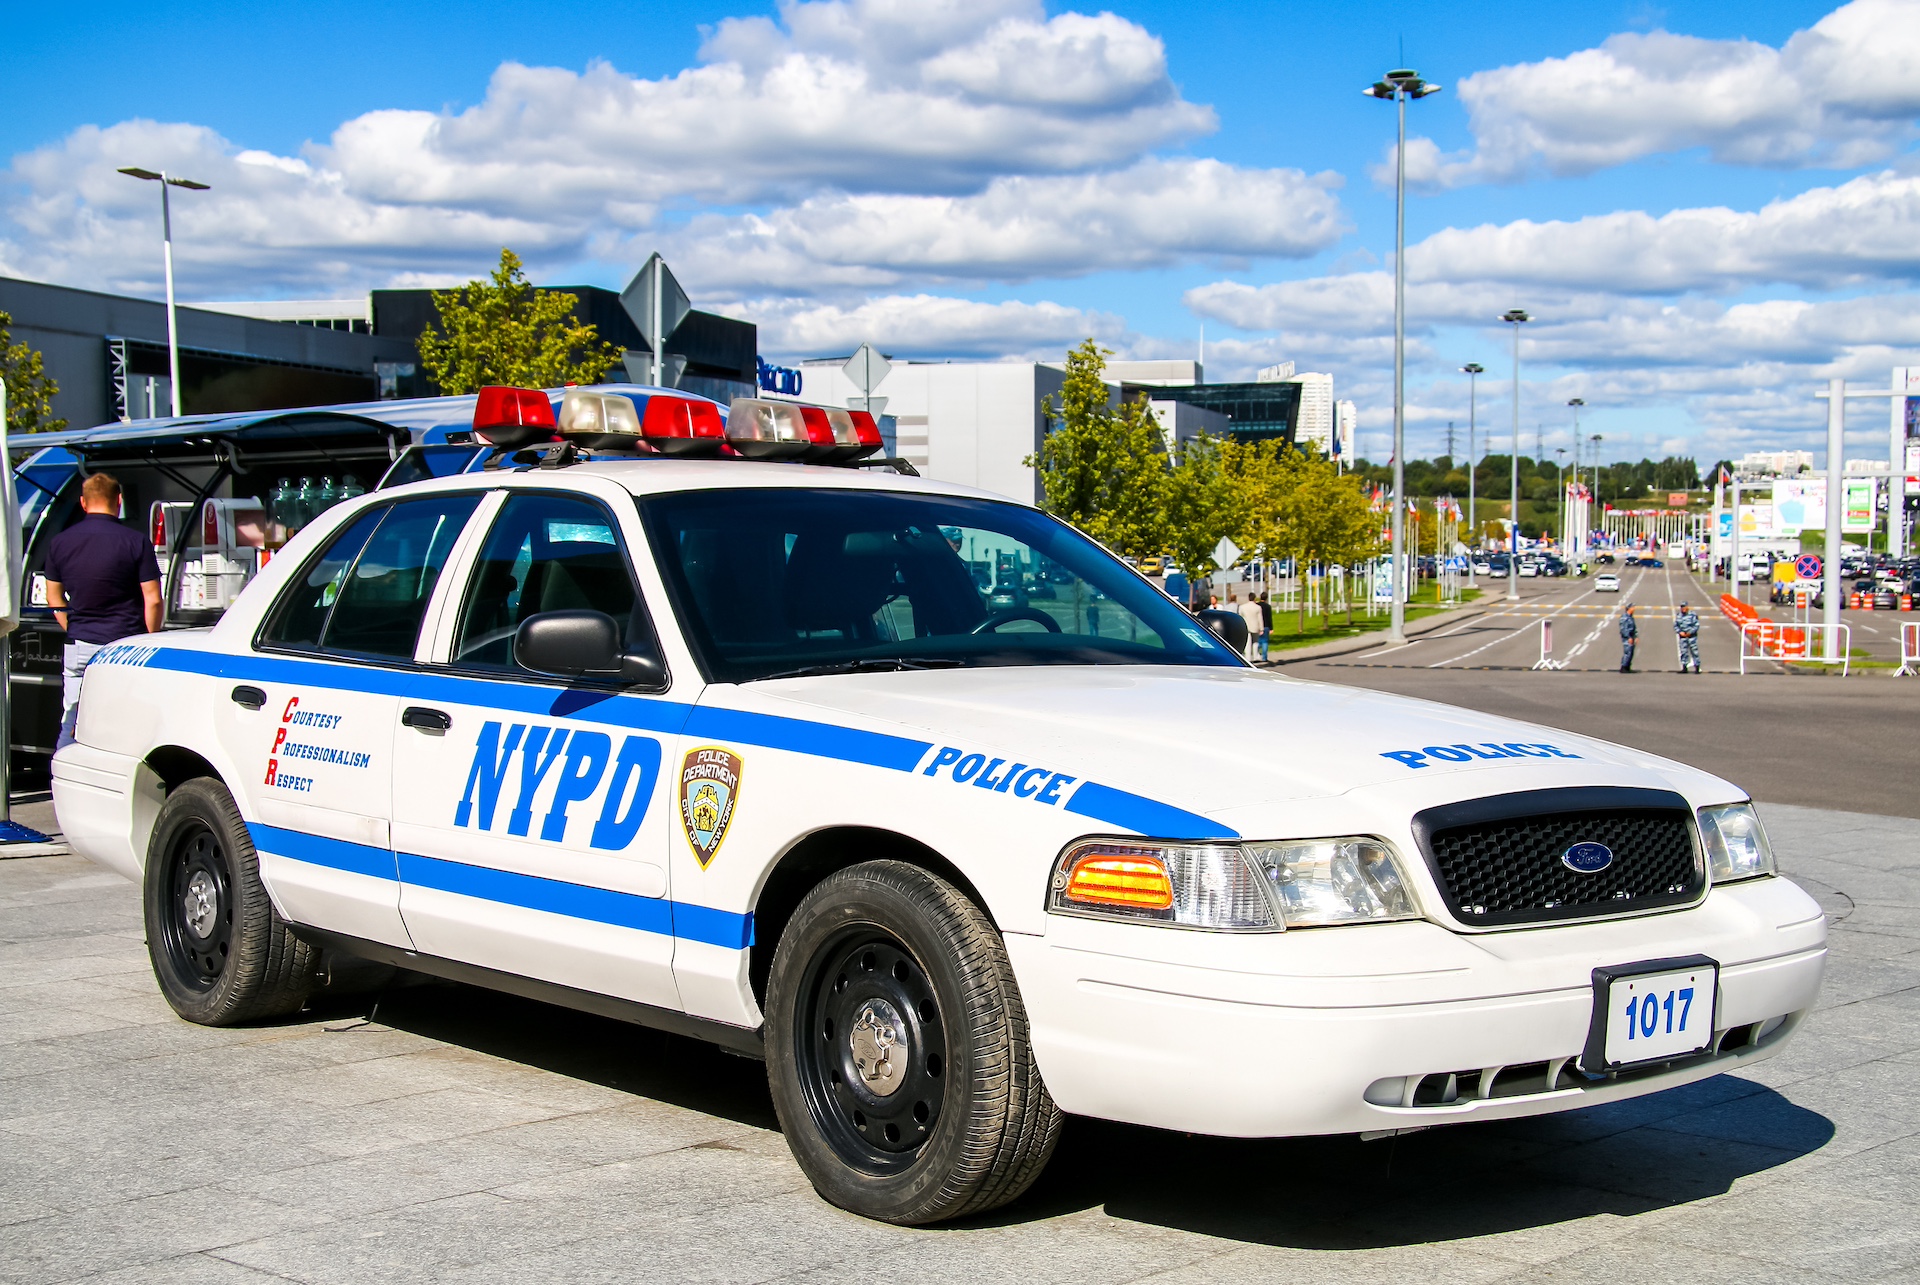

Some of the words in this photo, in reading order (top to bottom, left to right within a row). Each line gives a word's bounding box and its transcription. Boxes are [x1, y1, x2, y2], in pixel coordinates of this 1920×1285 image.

[282, 697, 342, 729] COURTESY
[271, 727, 371, 768] PROFESSIONALISM
[697, 750, 730, 767] POLICE
[1378, 742, 1586, 770] POLICE
[264, 758, 313, 792] RESPECT
[454, 721, 662, 850] NYPD
[683, 764, 737, 789] DEPARTMENT
[922, 746, 1078, 806] POLICE
[681, 799, 692, 827] CITY
[688, 830, 700, 846] OF
[708, 831, 722, 853] NEW
[720, 799, 734, 828] YORK
[1577, 847, 1603, 866] Ford
[1625, 987, 1695, 1041] 1017
